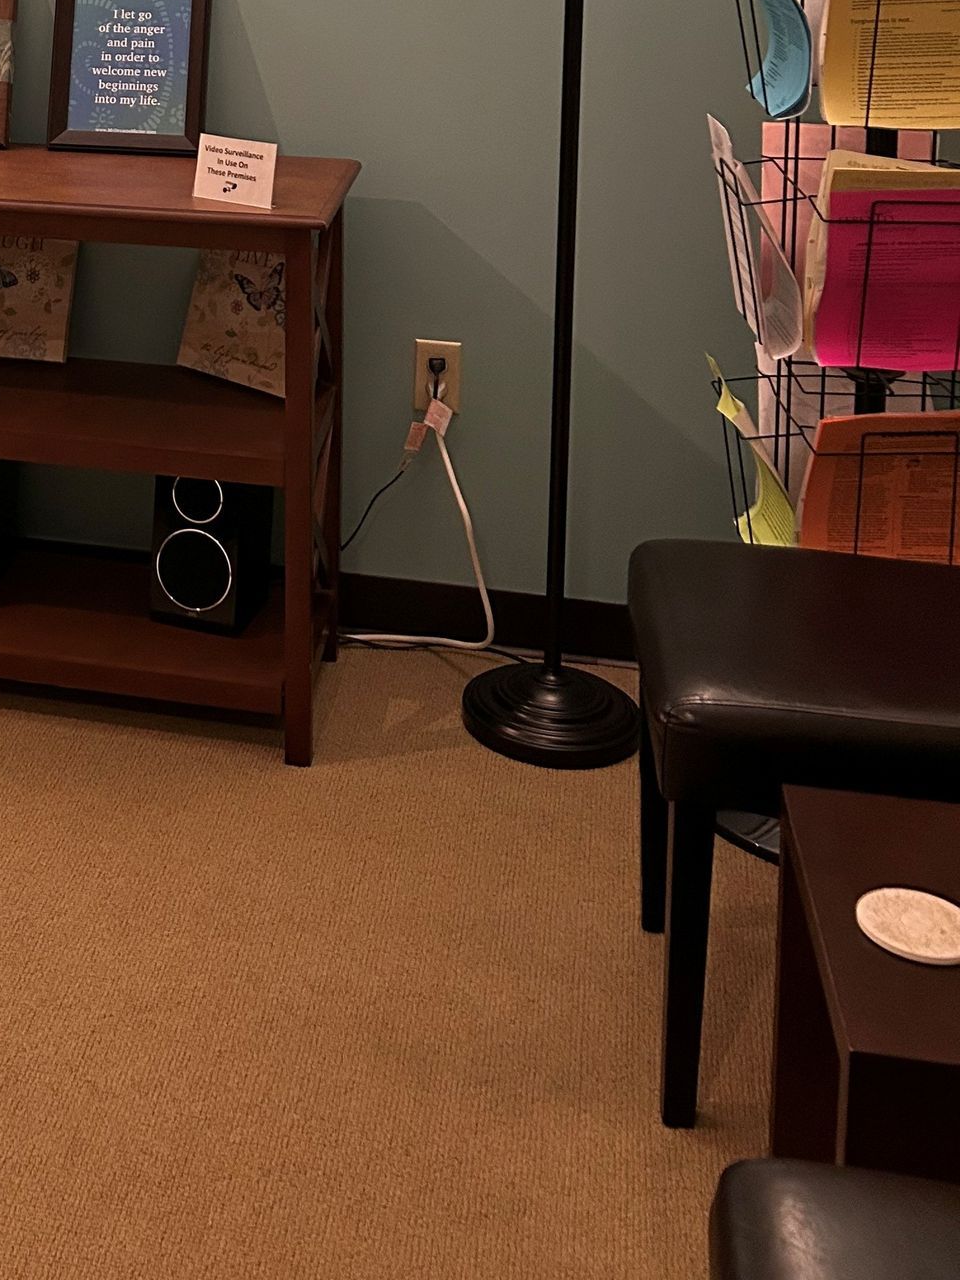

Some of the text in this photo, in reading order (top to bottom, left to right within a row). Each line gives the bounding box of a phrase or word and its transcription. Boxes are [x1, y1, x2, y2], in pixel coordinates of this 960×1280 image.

[113, 9, 152, 22] I let go
[98, 22, 166, 36] of the anger
[107, 37, 155, 51] and pain
[101, 51, 160, 63] in order to
[92, 65, 167, 77] welcome new
[98, 79, 159, 93] beginnings
[94, 93, 161, 107] into my life.
[205, 144, 264, 160] Video Surveillance
[225, 159, 237, 167] Use
[238, 161, 248, 169] On
[207, 166, 256, 182] These Premises
[234, 249, 274, 268] LIVE
